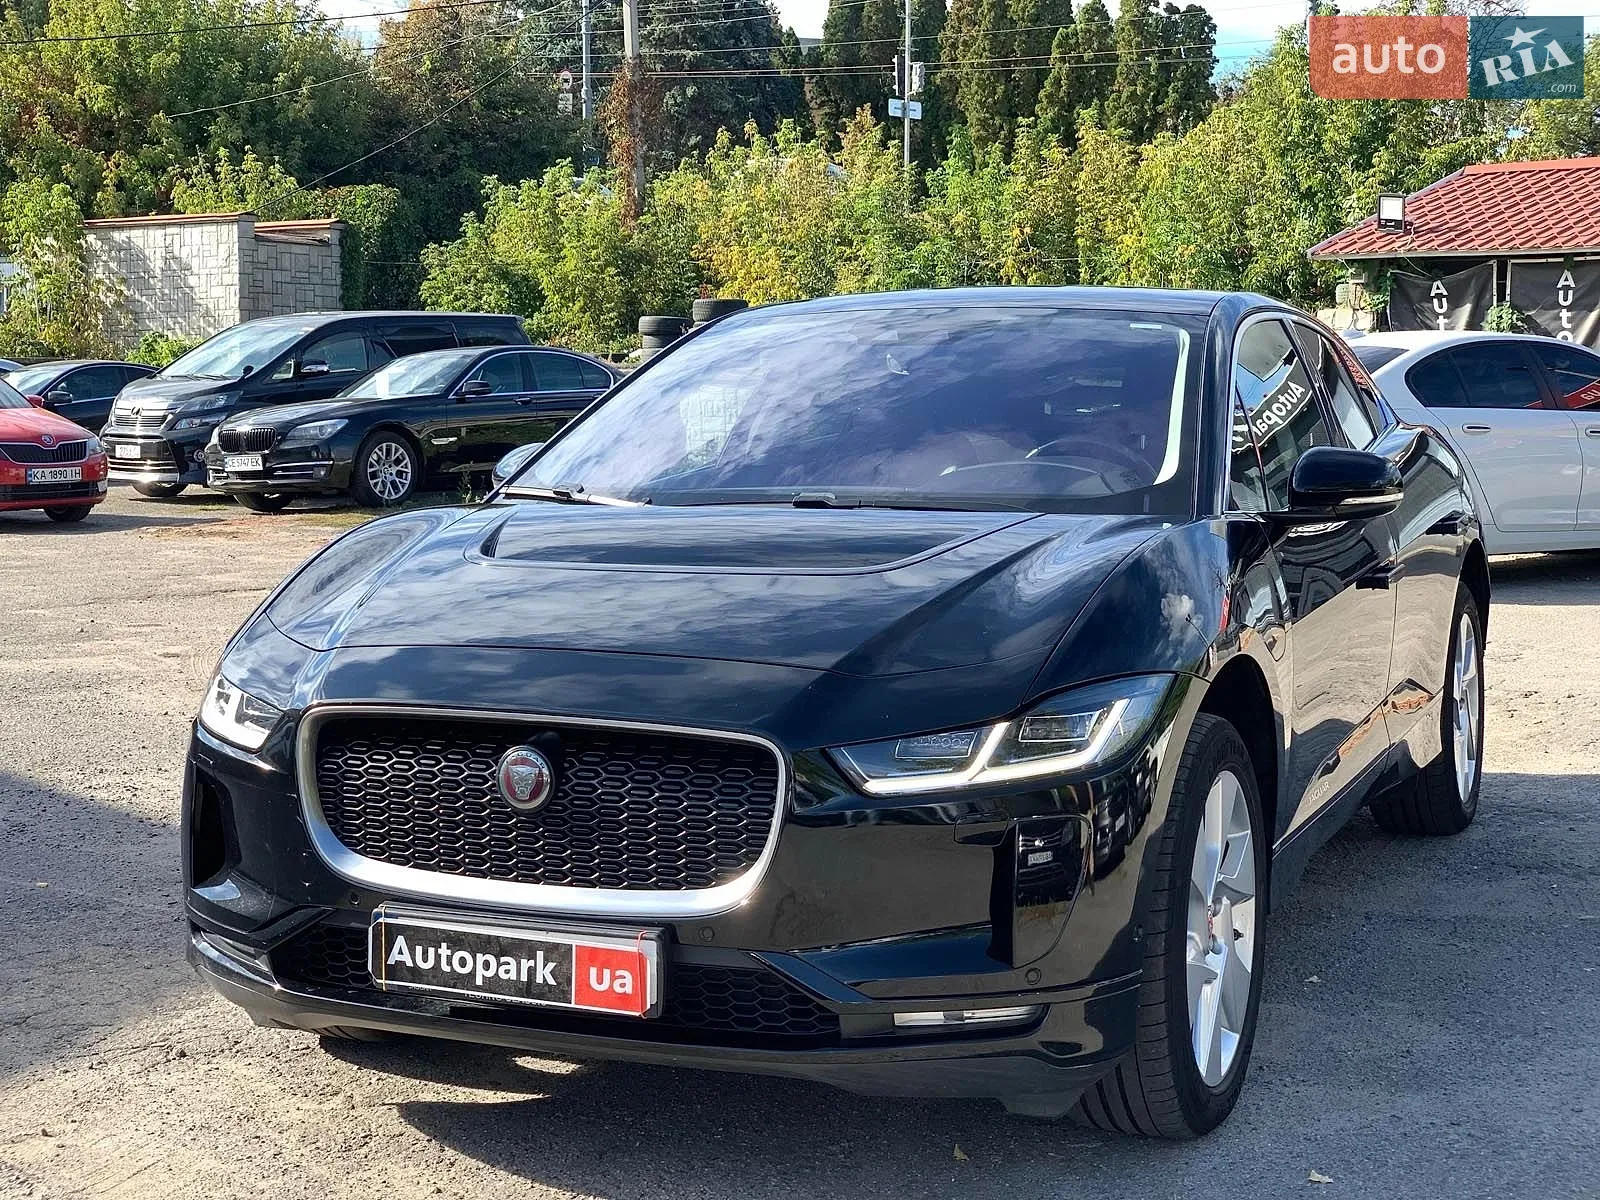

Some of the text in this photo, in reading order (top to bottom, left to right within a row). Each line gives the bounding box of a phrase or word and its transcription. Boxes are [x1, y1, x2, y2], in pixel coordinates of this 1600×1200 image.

[33, 470, 47, 480] KA
[48, 469, 68, 480] 1890
[387, 935, 634, 995] Autopark ua
